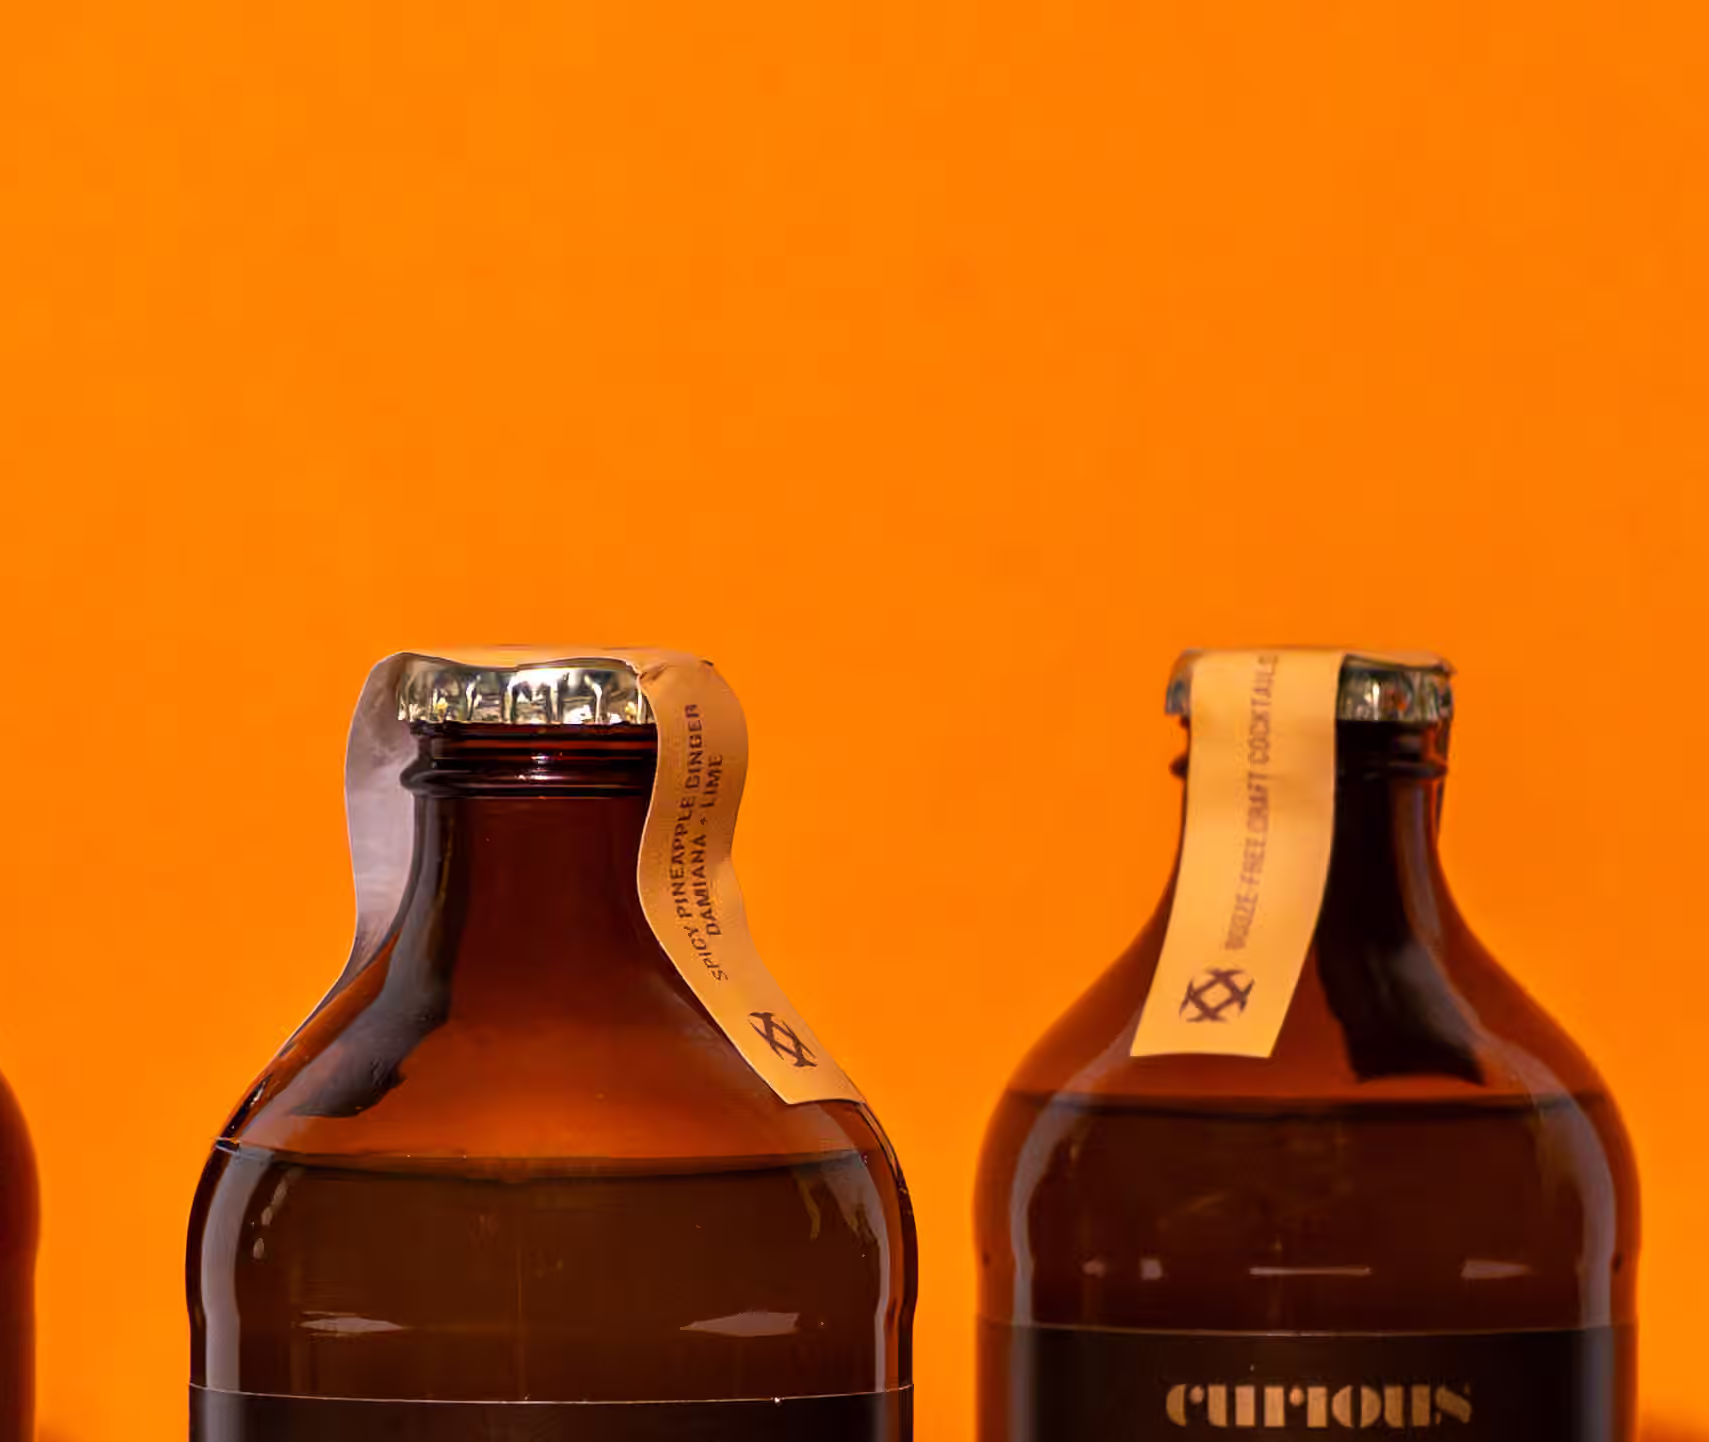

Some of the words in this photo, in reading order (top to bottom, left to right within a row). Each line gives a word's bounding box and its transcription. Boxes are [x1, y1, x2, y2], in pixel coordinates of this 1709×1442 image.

[700, 753, 724, 809] LIME
[669, 791, 696, 919] PINEAPPLE
[690, 834, 722, 936] DAMIANA
[1166, 1383, 1473, 1427] curious
